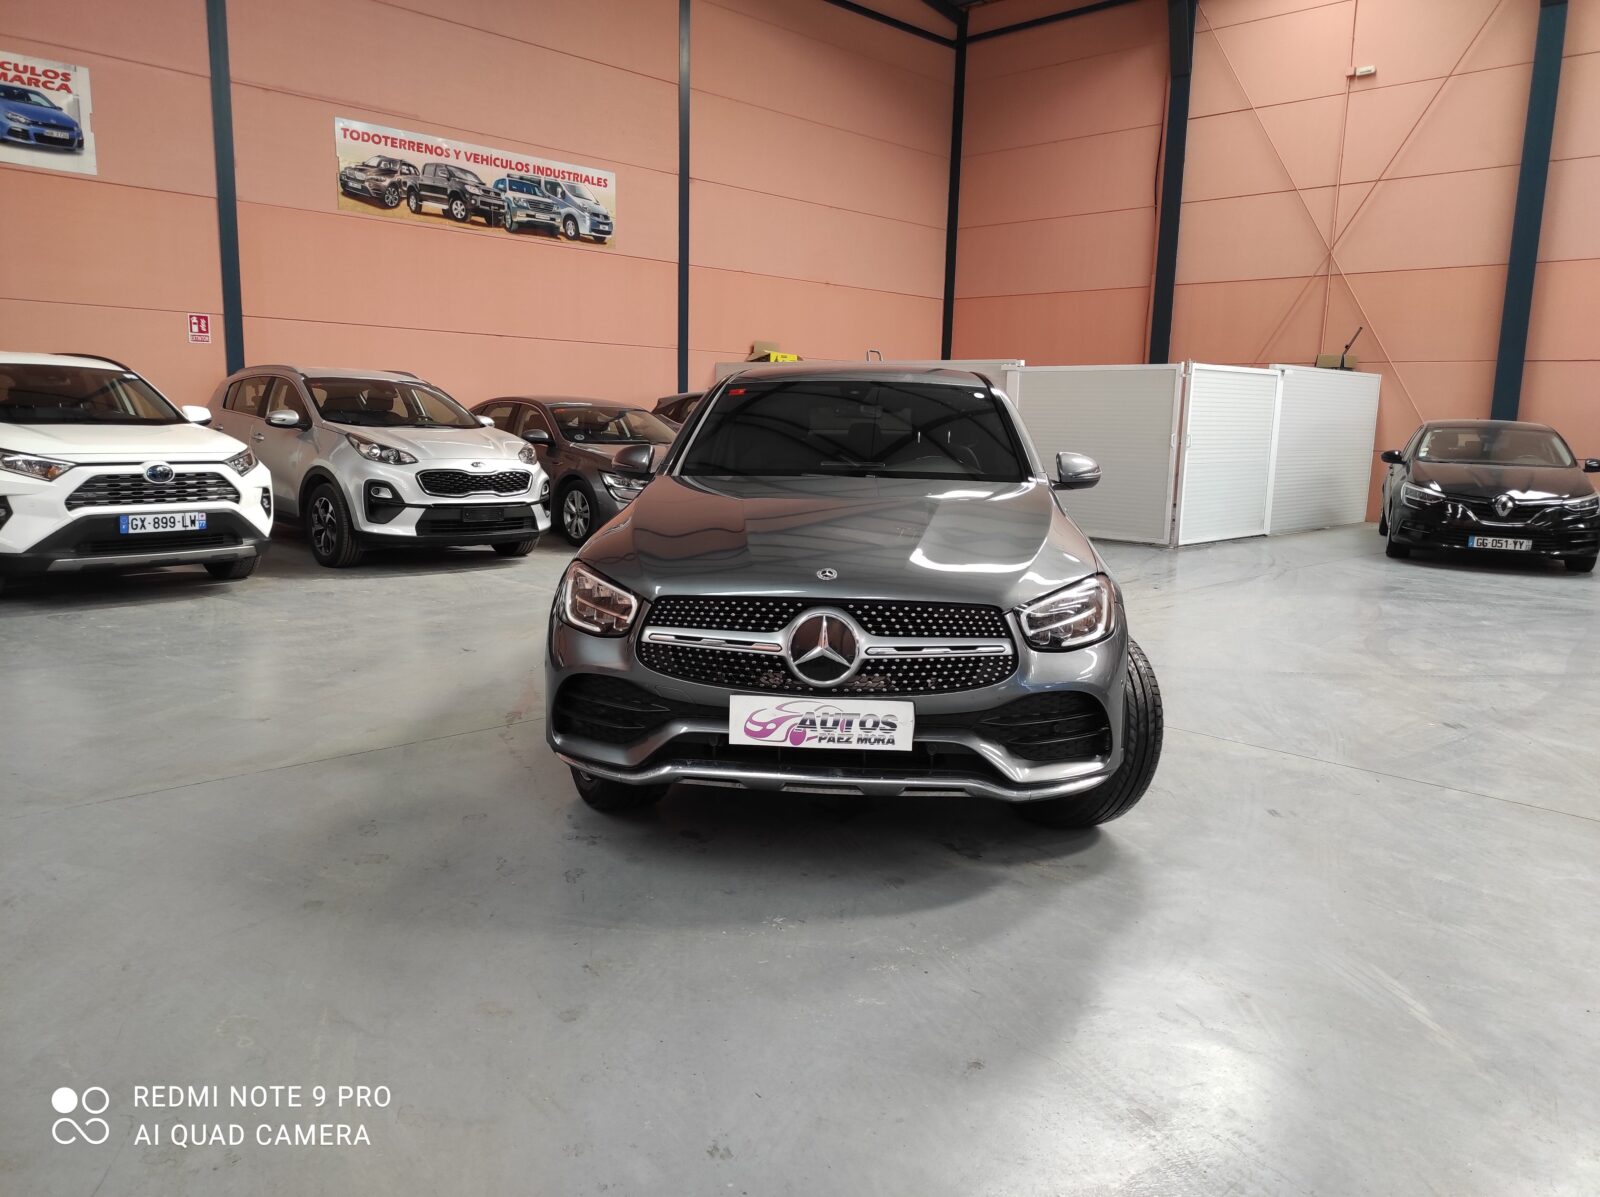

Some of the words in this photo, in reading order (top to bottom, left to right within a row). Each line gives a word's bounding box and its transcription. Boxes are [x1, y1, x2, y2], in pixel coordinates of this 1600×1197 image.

[341, 128, 451, 158] TODOTERRENOS
[453, 149, 461, 160] Y
[464, 151, 530, 173] VEHÍCULOS
[533, 165, 608, 188] INDUSTRIALES
[797, 711, 898, 733] AUTOS
[857, 734, 896, 745] MORA
